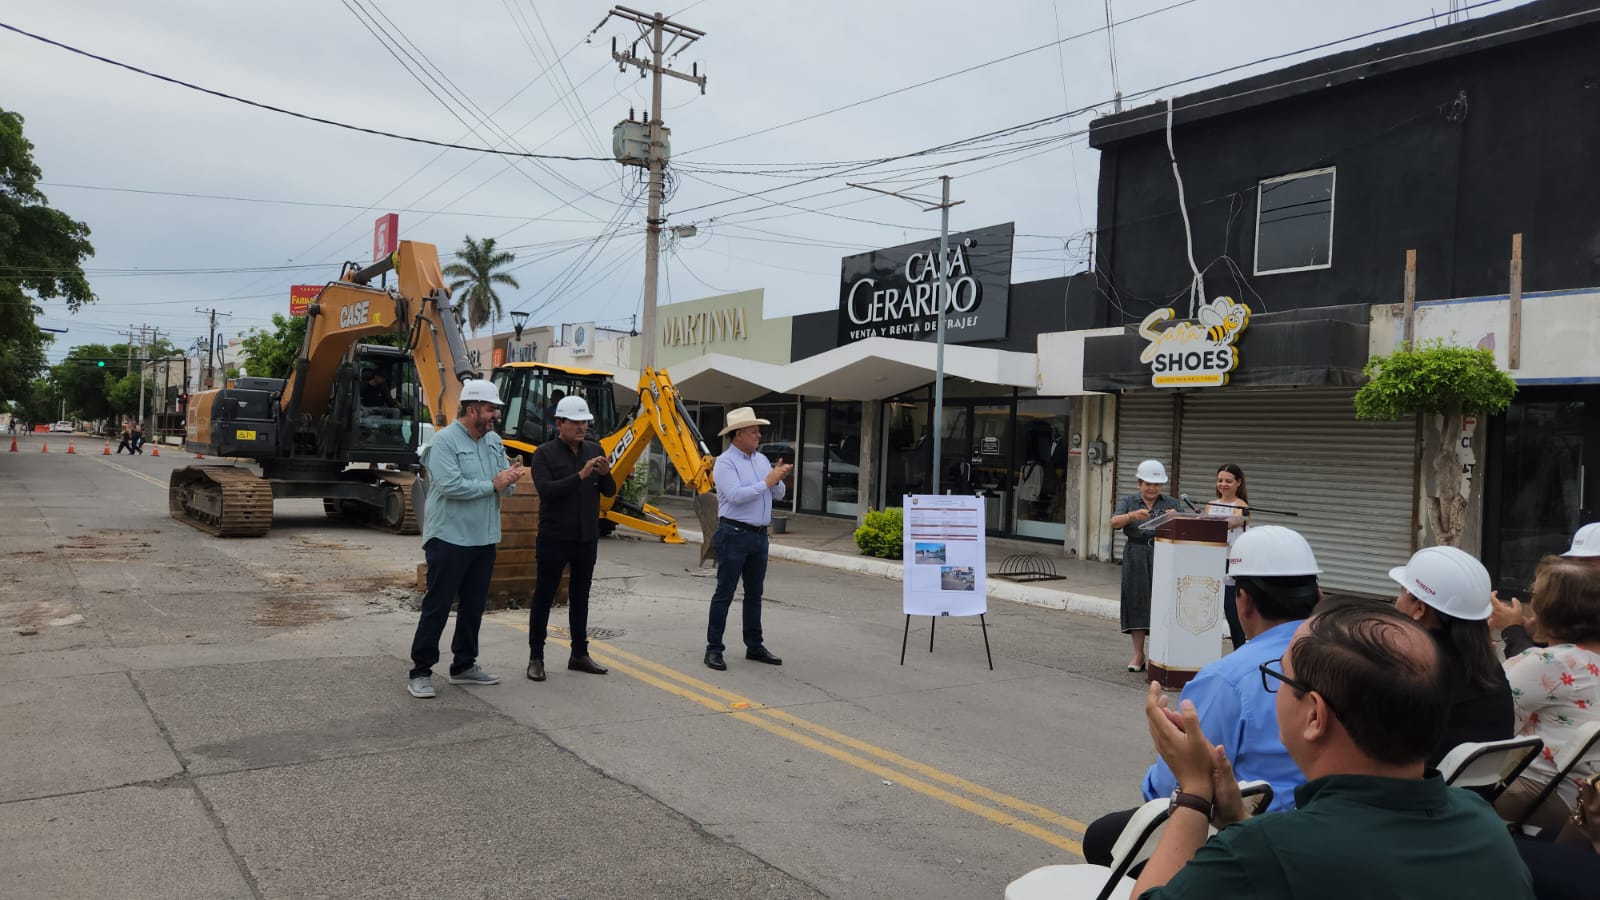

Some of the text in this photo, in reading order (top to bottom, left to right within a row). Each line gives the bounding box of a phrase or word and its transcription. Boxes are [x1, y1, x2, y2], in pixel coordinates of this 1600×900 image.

[340, 300, 370, 329] CASE
[663, 304, 748, 347] MARTINNA
[850, 315, 979, 340] VENTA Y RENTA DE RAJES
[1154, 349, 1229, 372] SHOES
[609, 428, 634, 469] JCB
